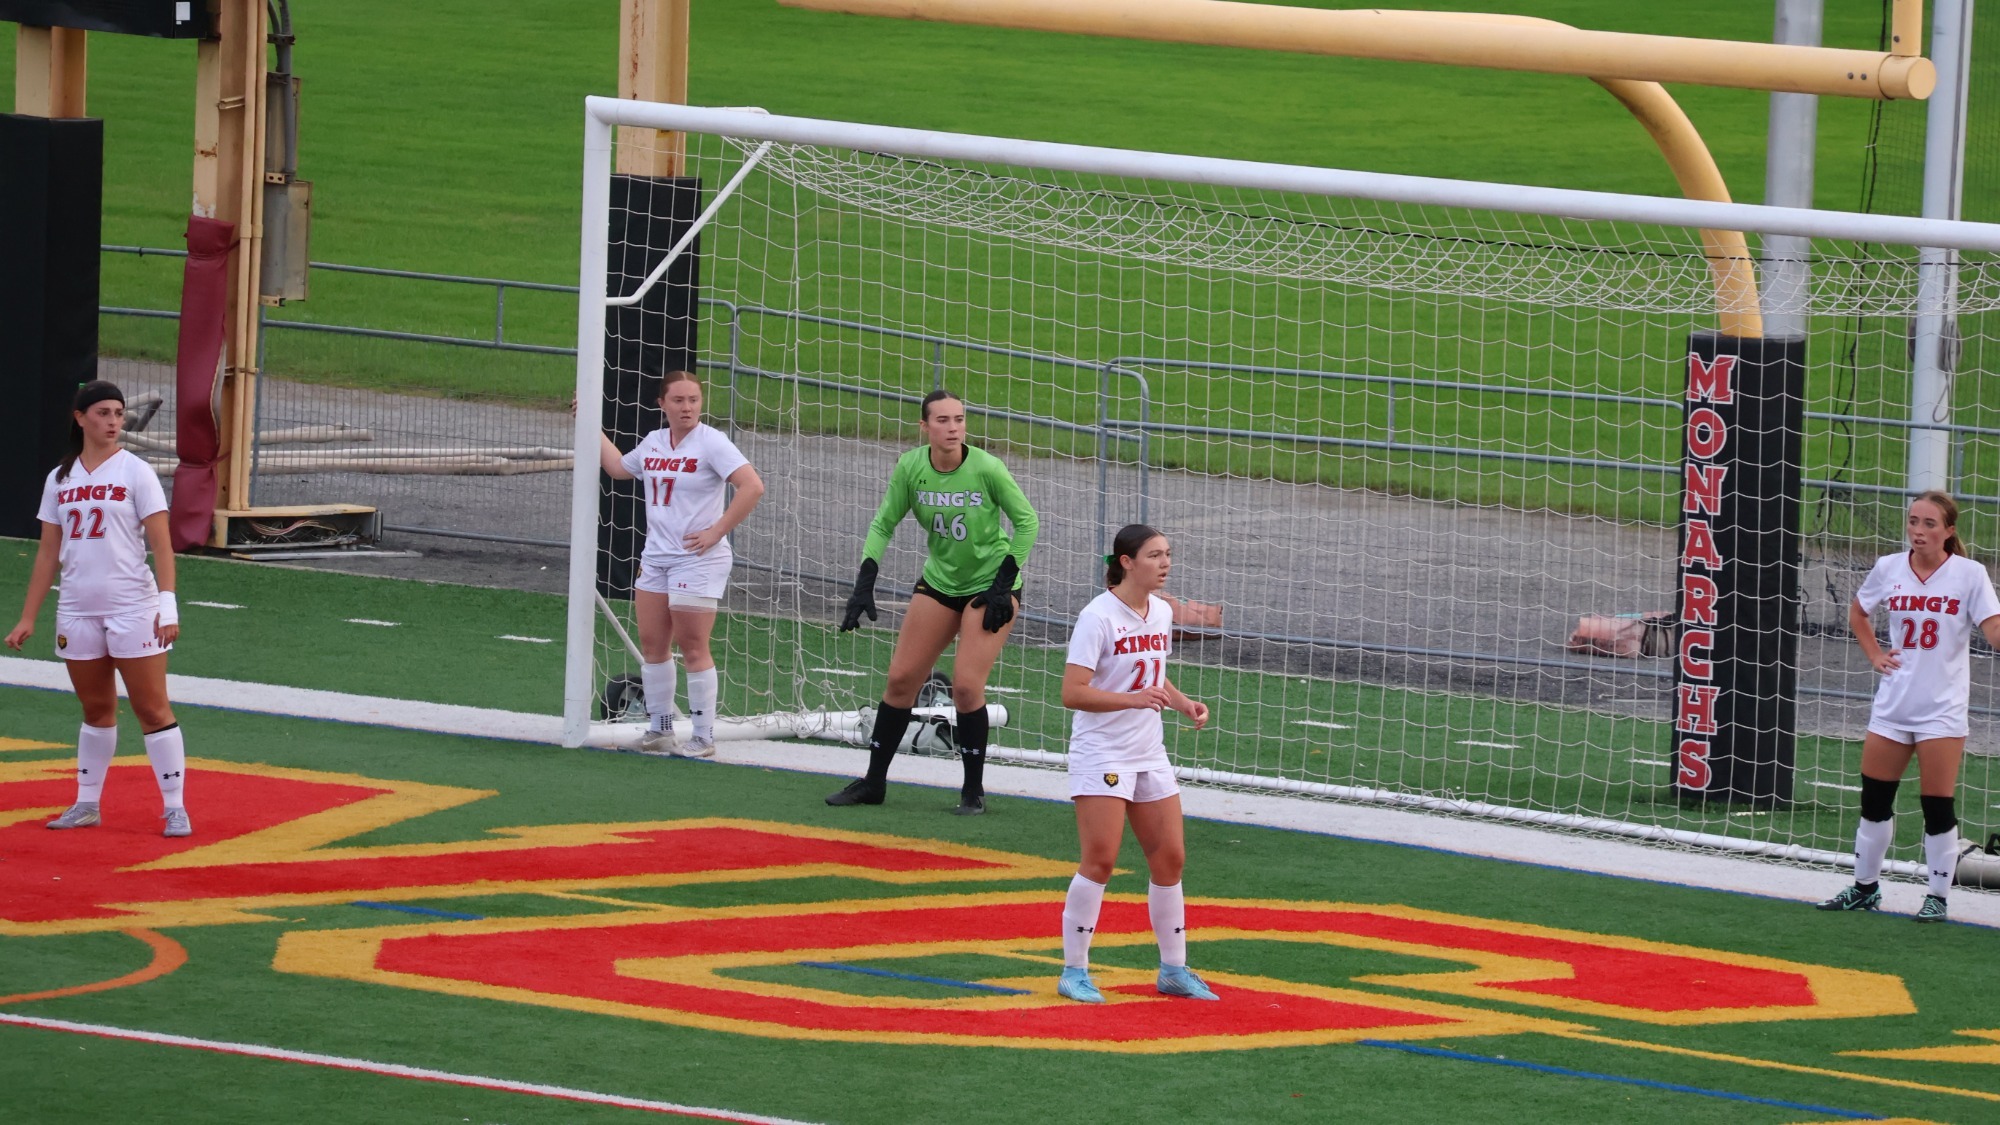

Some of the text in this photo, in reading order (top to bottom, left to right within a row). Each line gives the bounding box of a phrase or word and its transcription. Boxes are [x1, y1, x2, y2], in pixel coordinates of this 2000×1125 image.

[643, 456, 698, 473] KING'S
[57, 483, 127, 506] KING'S
[650, 476, 676, 506] 17
[915, 489, 983, 507] KING'S
[67, 506, 107, 540] 22
[932, 511, 968, 542] 46
[1676, 351, 1738, 790] MONARCHS
[1888, 595, 1960, 615] KING'S
[1901, 617, 1939, 650] 28
[1127, 657, 1161, 692] 21
